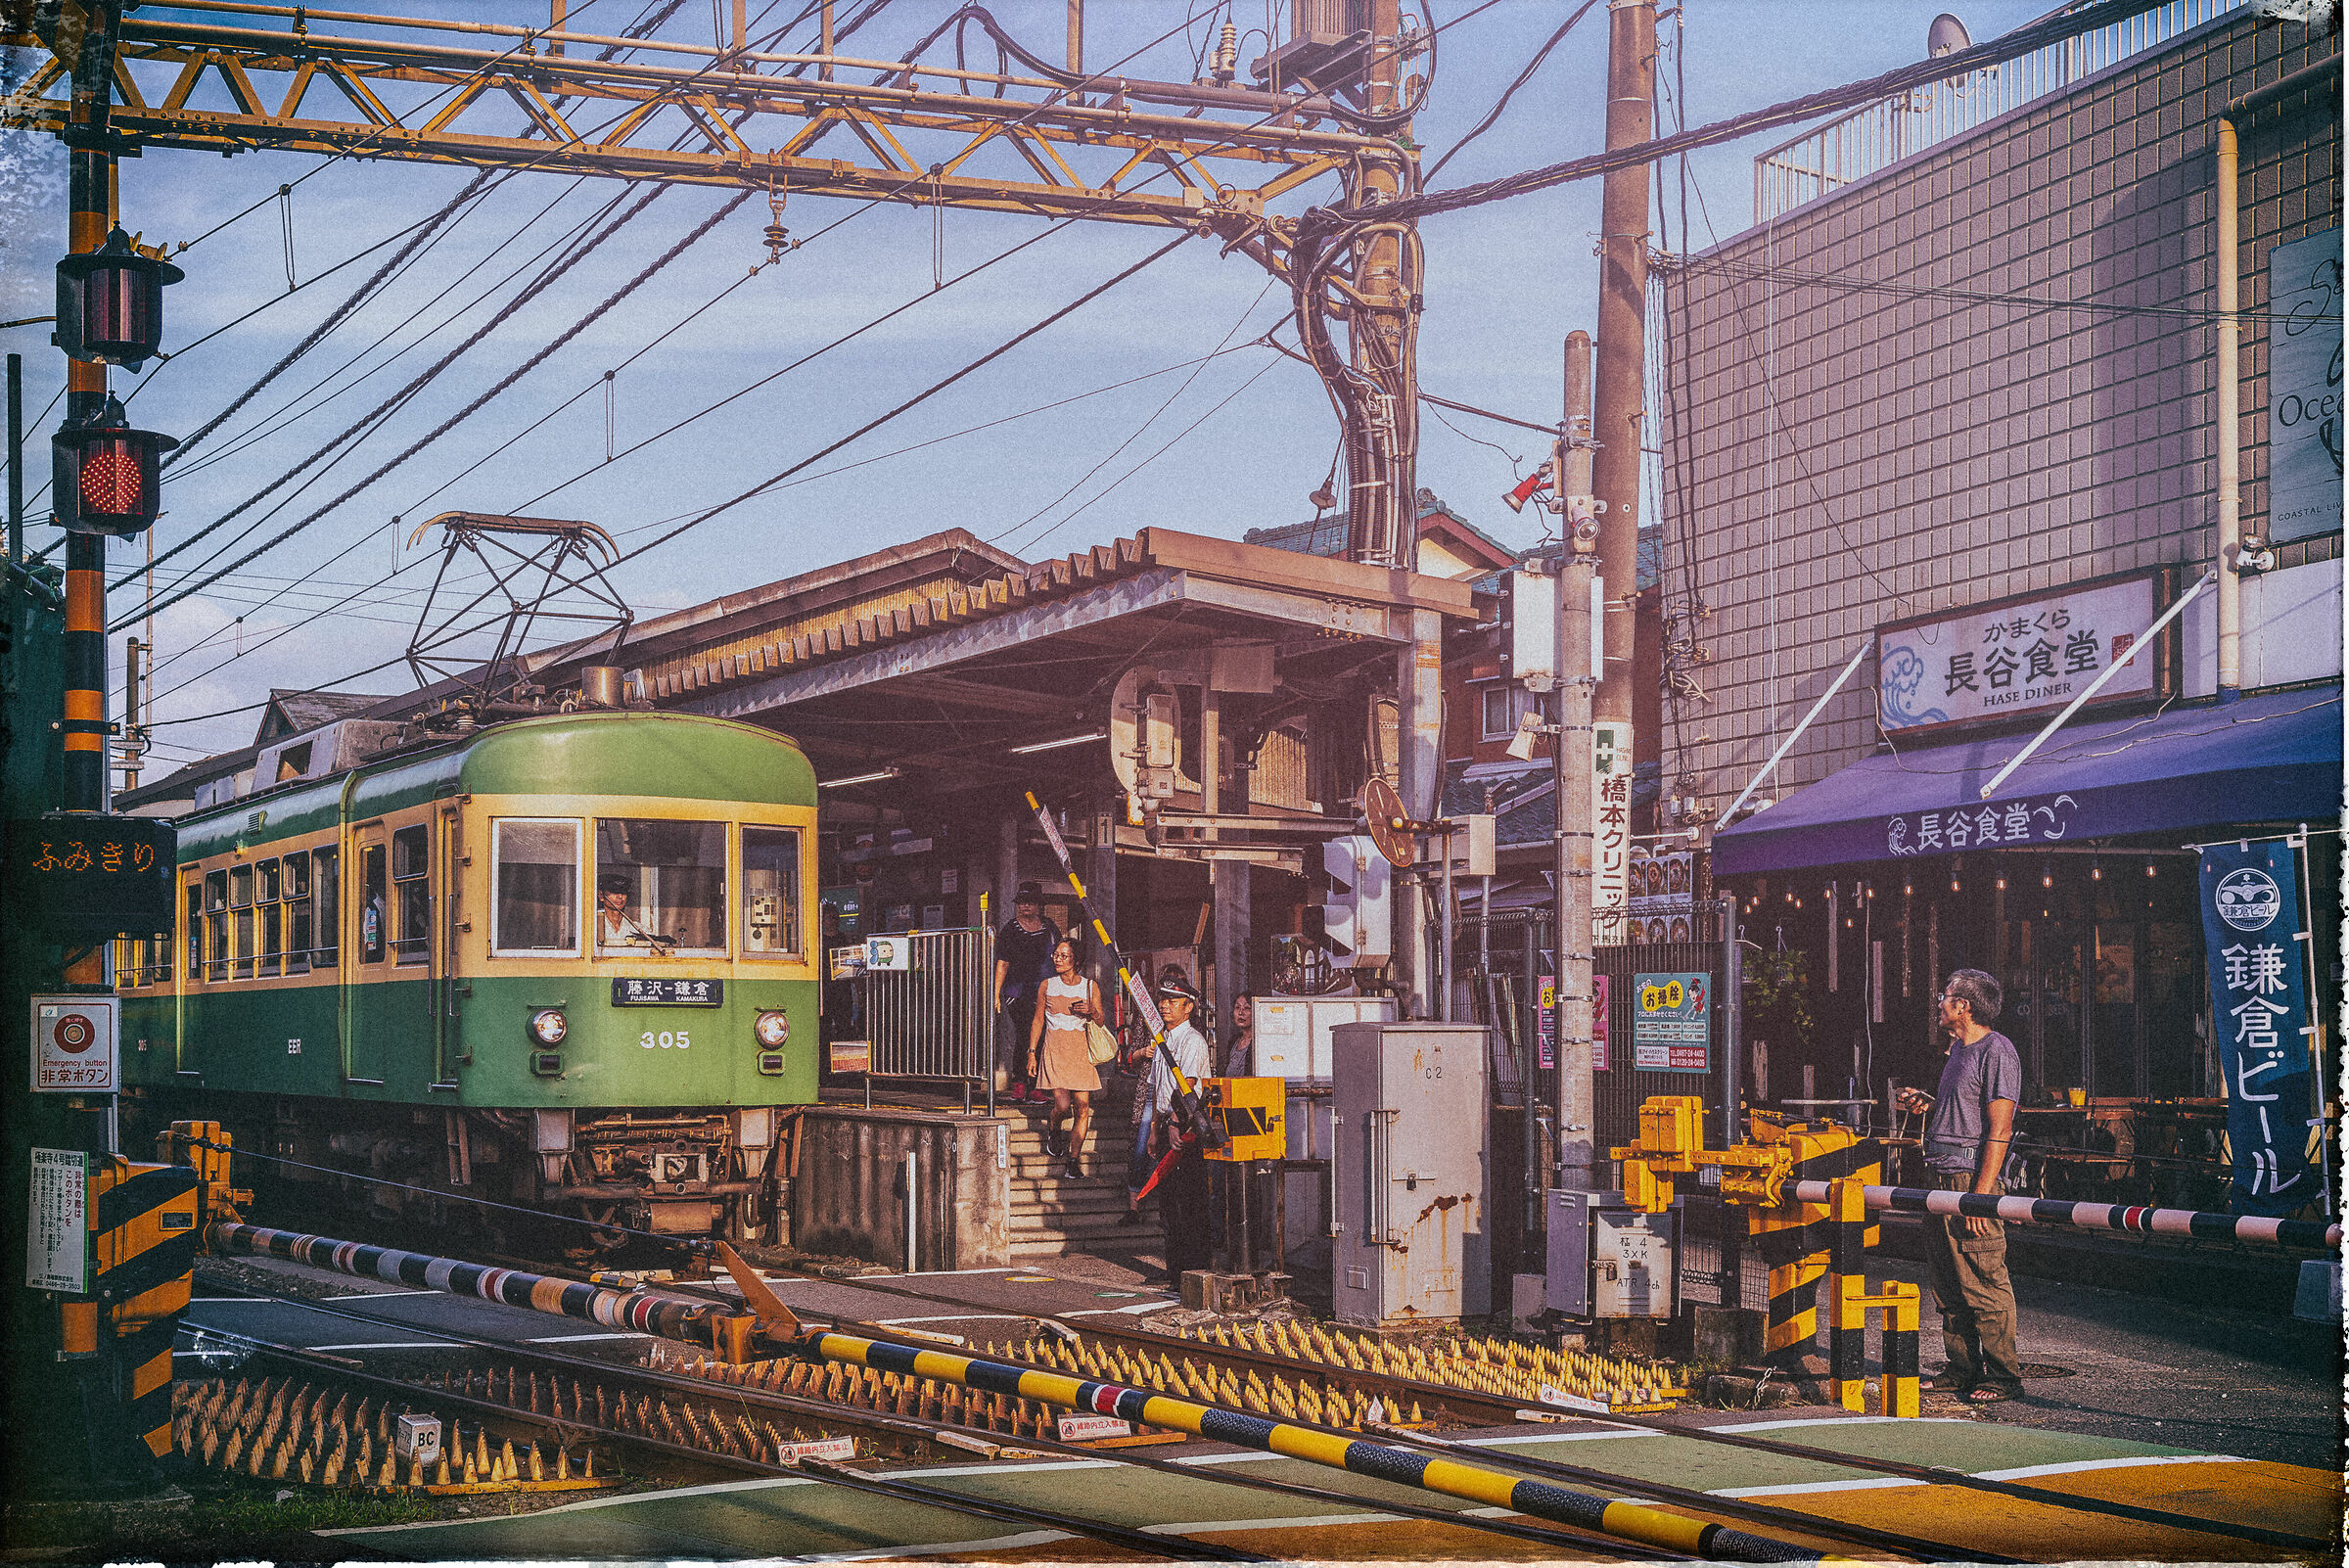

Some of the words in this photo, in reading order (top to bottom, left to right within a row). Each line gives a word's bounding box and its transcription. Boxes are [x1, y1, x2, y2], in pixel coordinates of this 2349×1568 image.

[2278, 505, 2323, 522] COASTAL
[1982, 608, 2071, 644] かまくら
[1944, 628, 2099, 697] 長谷食堂
[1984, 689, 2020, 708] HASE
[2025, 681, 2073, 702] DINER
[1101, 818, 1108, 844] 1
[1917, 802, 2031, 852] 長谷食堂
[33, 841, 155, 873] ふみきり
[1599, 777, 1628, 929] 橋本クリニック
[2223, 904, 2277, 917] 鎌倉ビール
[1646, 986, 1680, 1007] お掃除
[288, 1038, 301, 1054] EER
[639, 1031, 691, 1049] 305
[43, 1059, 81, 1068] Emergency
[2220, 943, 2302, 1196] 鎌倉ビール
[41, 1069, 109, 1084] 非常ボタン
[1639, 1237, 1647, 1248] 4
[1616, 1278, 1637, 1288] ATR
[418, 1431, 435, 1447] BC
